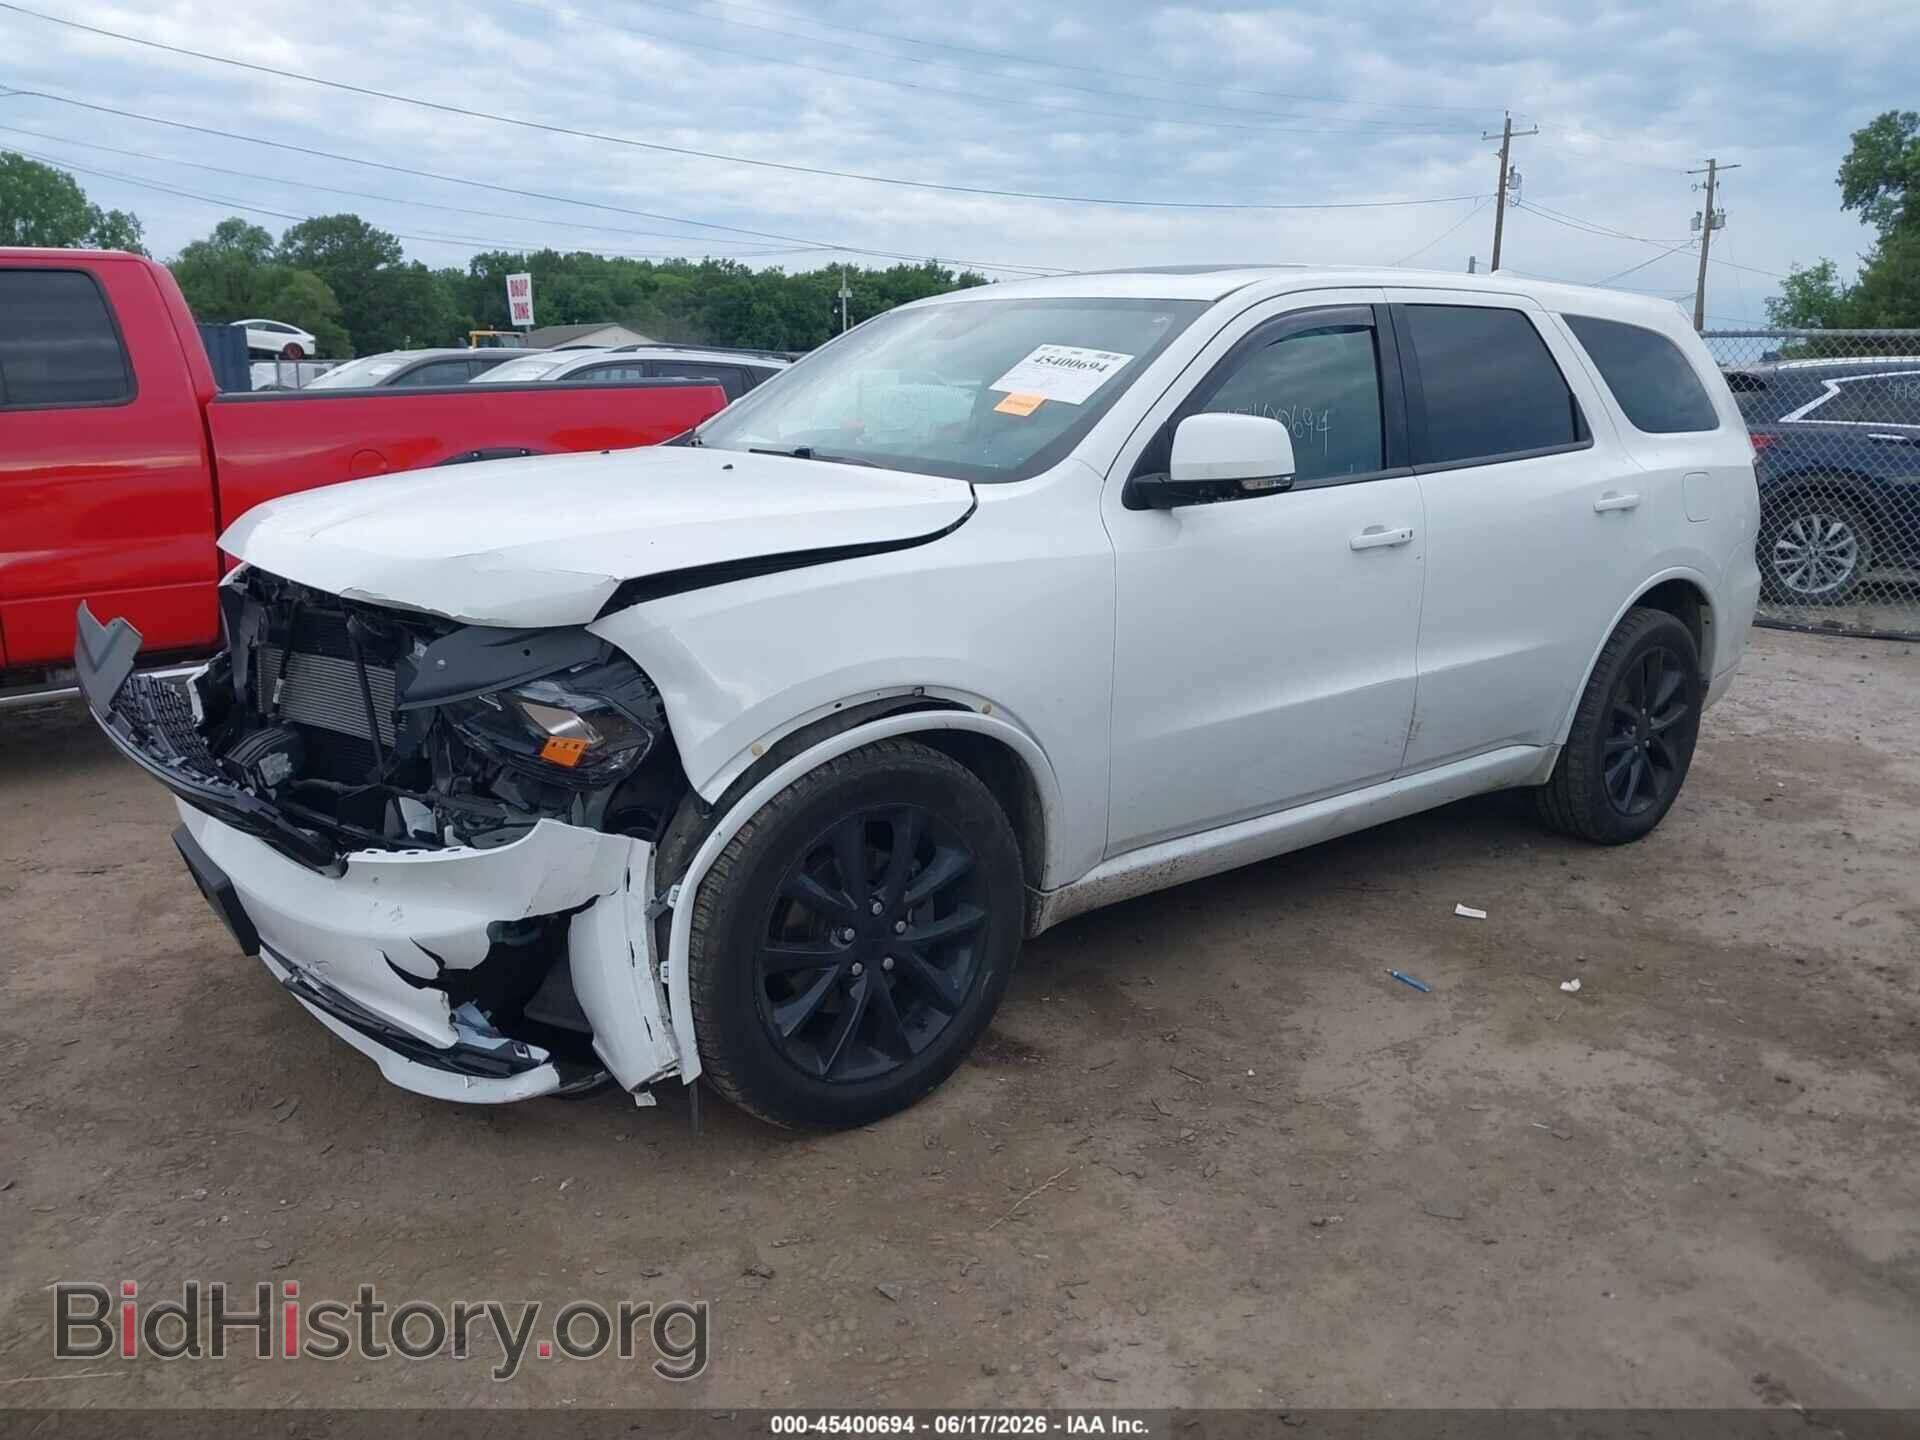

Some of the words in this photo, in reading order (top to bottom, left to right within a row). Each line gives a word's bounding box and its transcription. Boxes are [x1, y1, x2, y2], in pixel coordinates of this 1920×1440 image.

[510, 279, 528, 296] DROP
[513, 303, 530, 320] ZONE
[1033, 355, 1110, 373] 45400694
